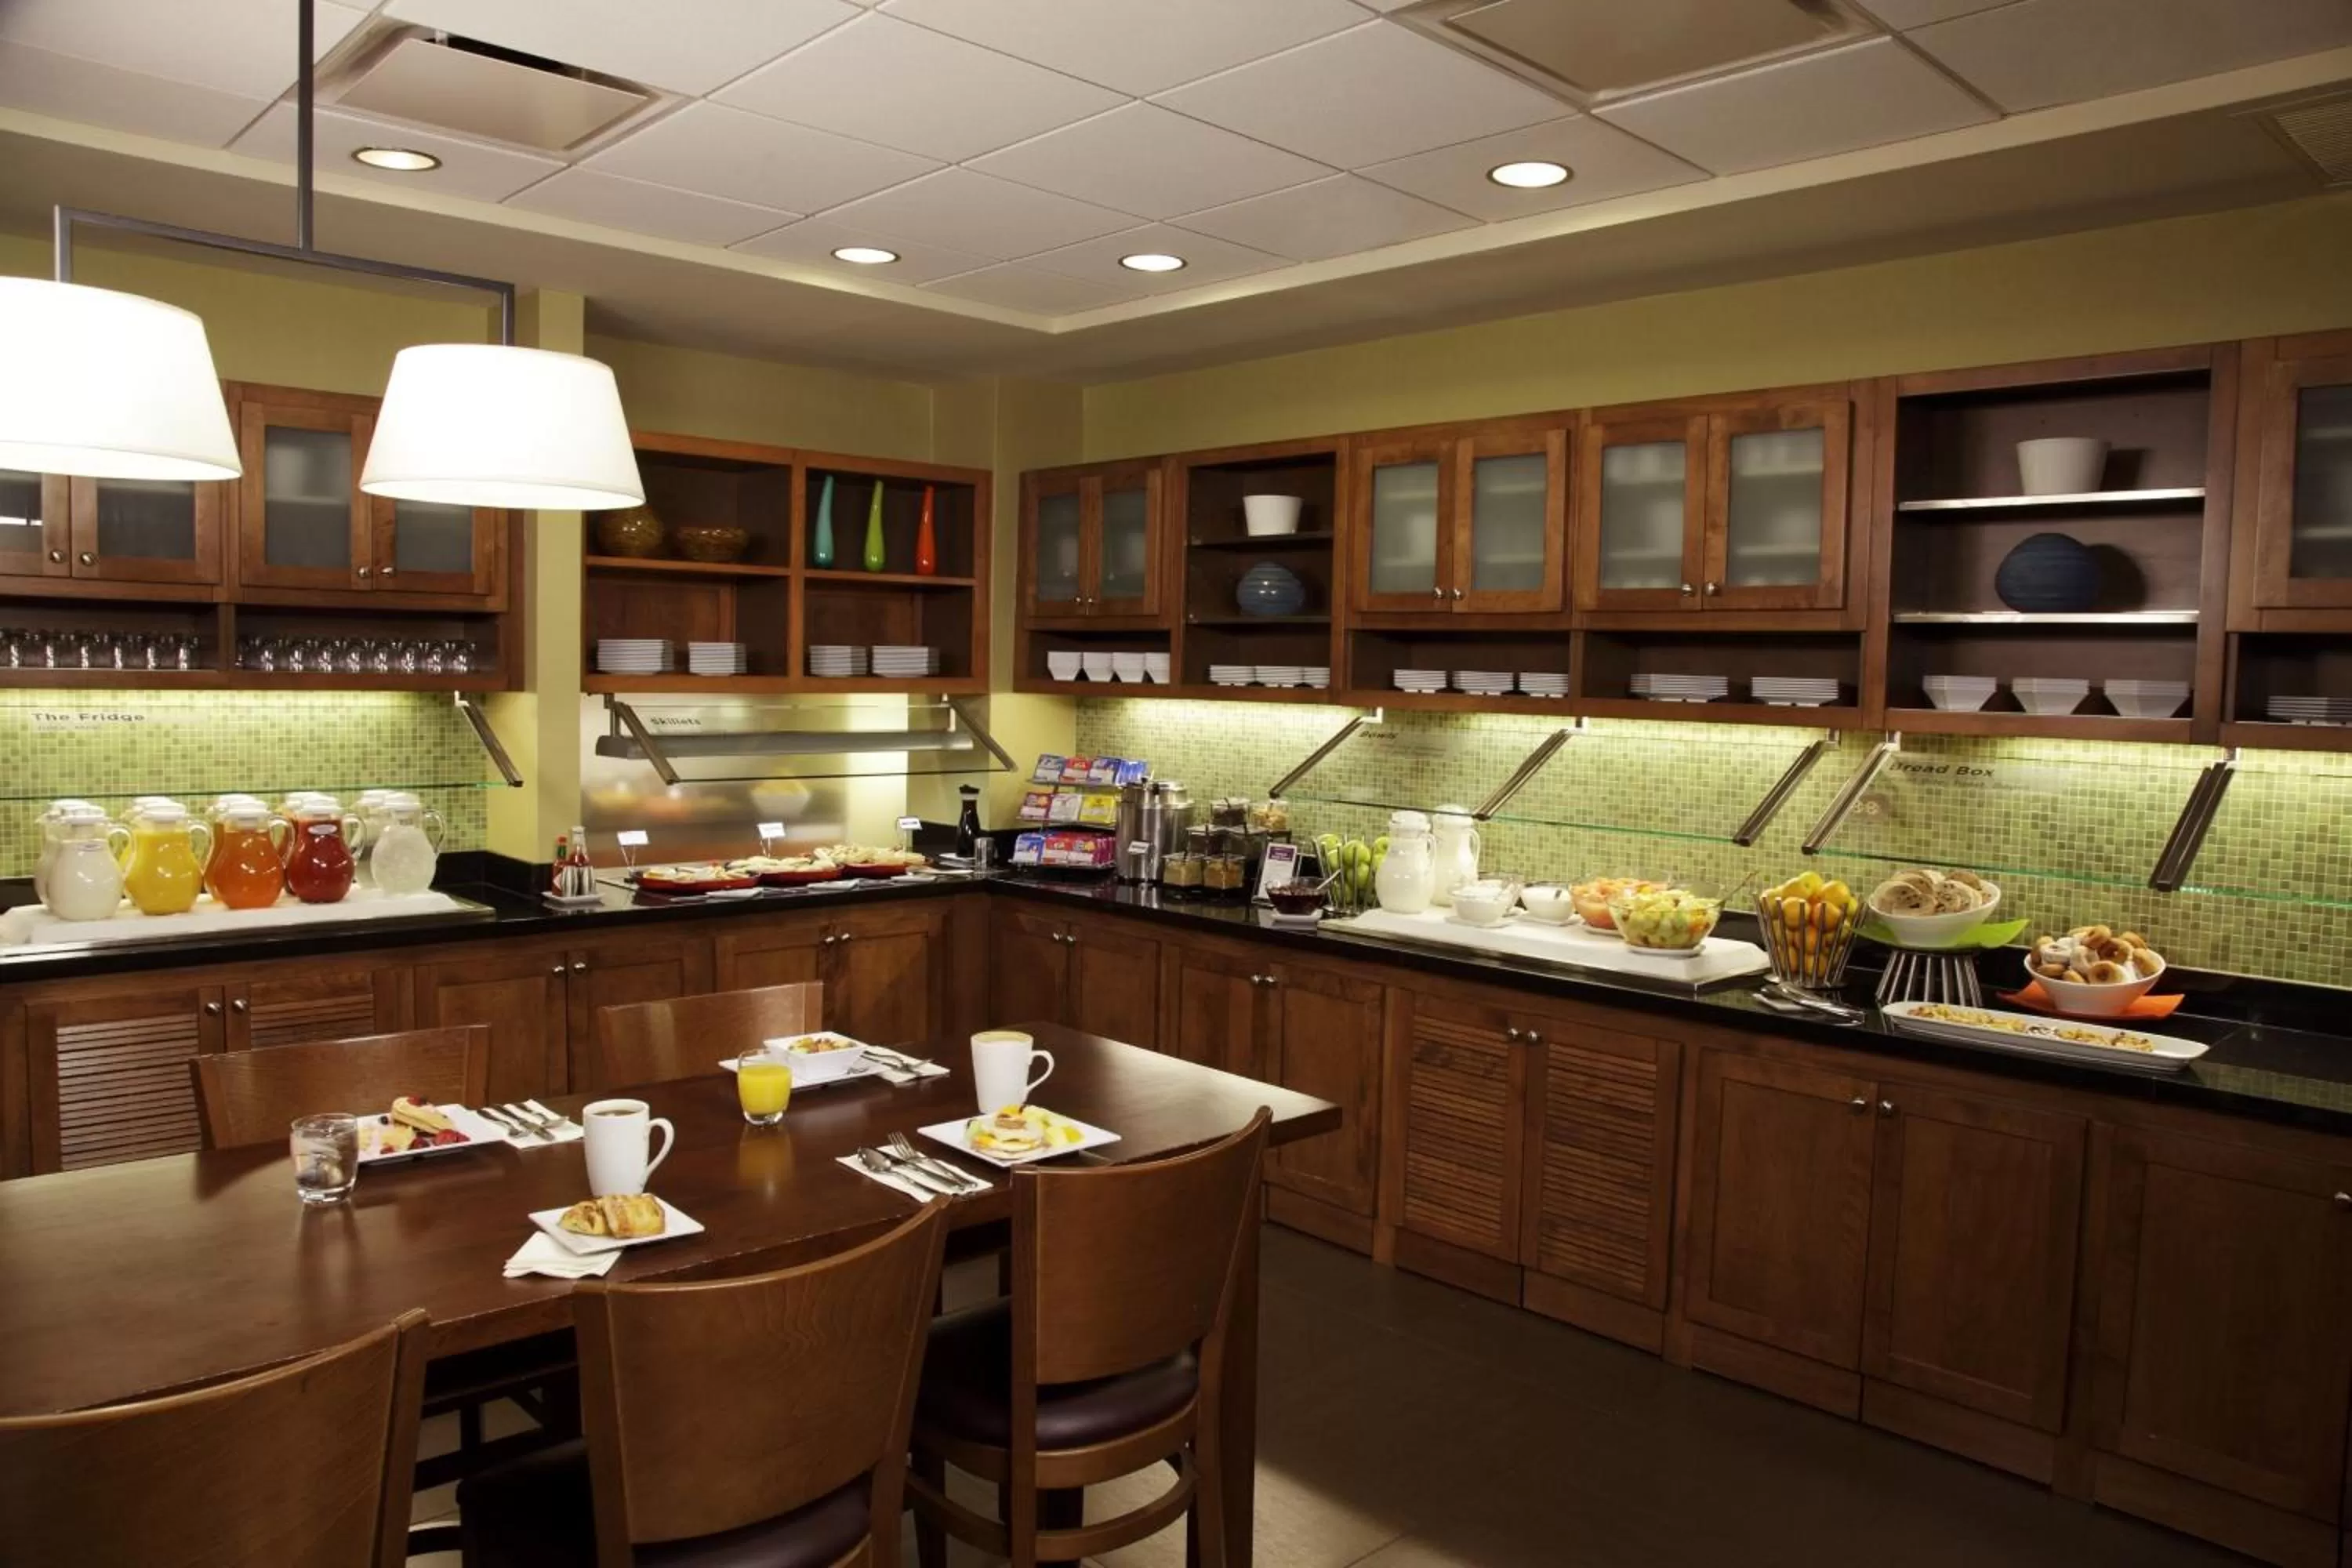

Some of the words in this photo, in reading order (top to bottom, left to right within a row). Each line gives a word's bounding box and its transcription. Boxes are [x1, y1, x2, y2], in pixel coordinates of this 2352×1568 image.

[31, 712, 71, 722] The
[78, 712, 146, 722] Fridge
[1955, 765, 1995, 778] Box
